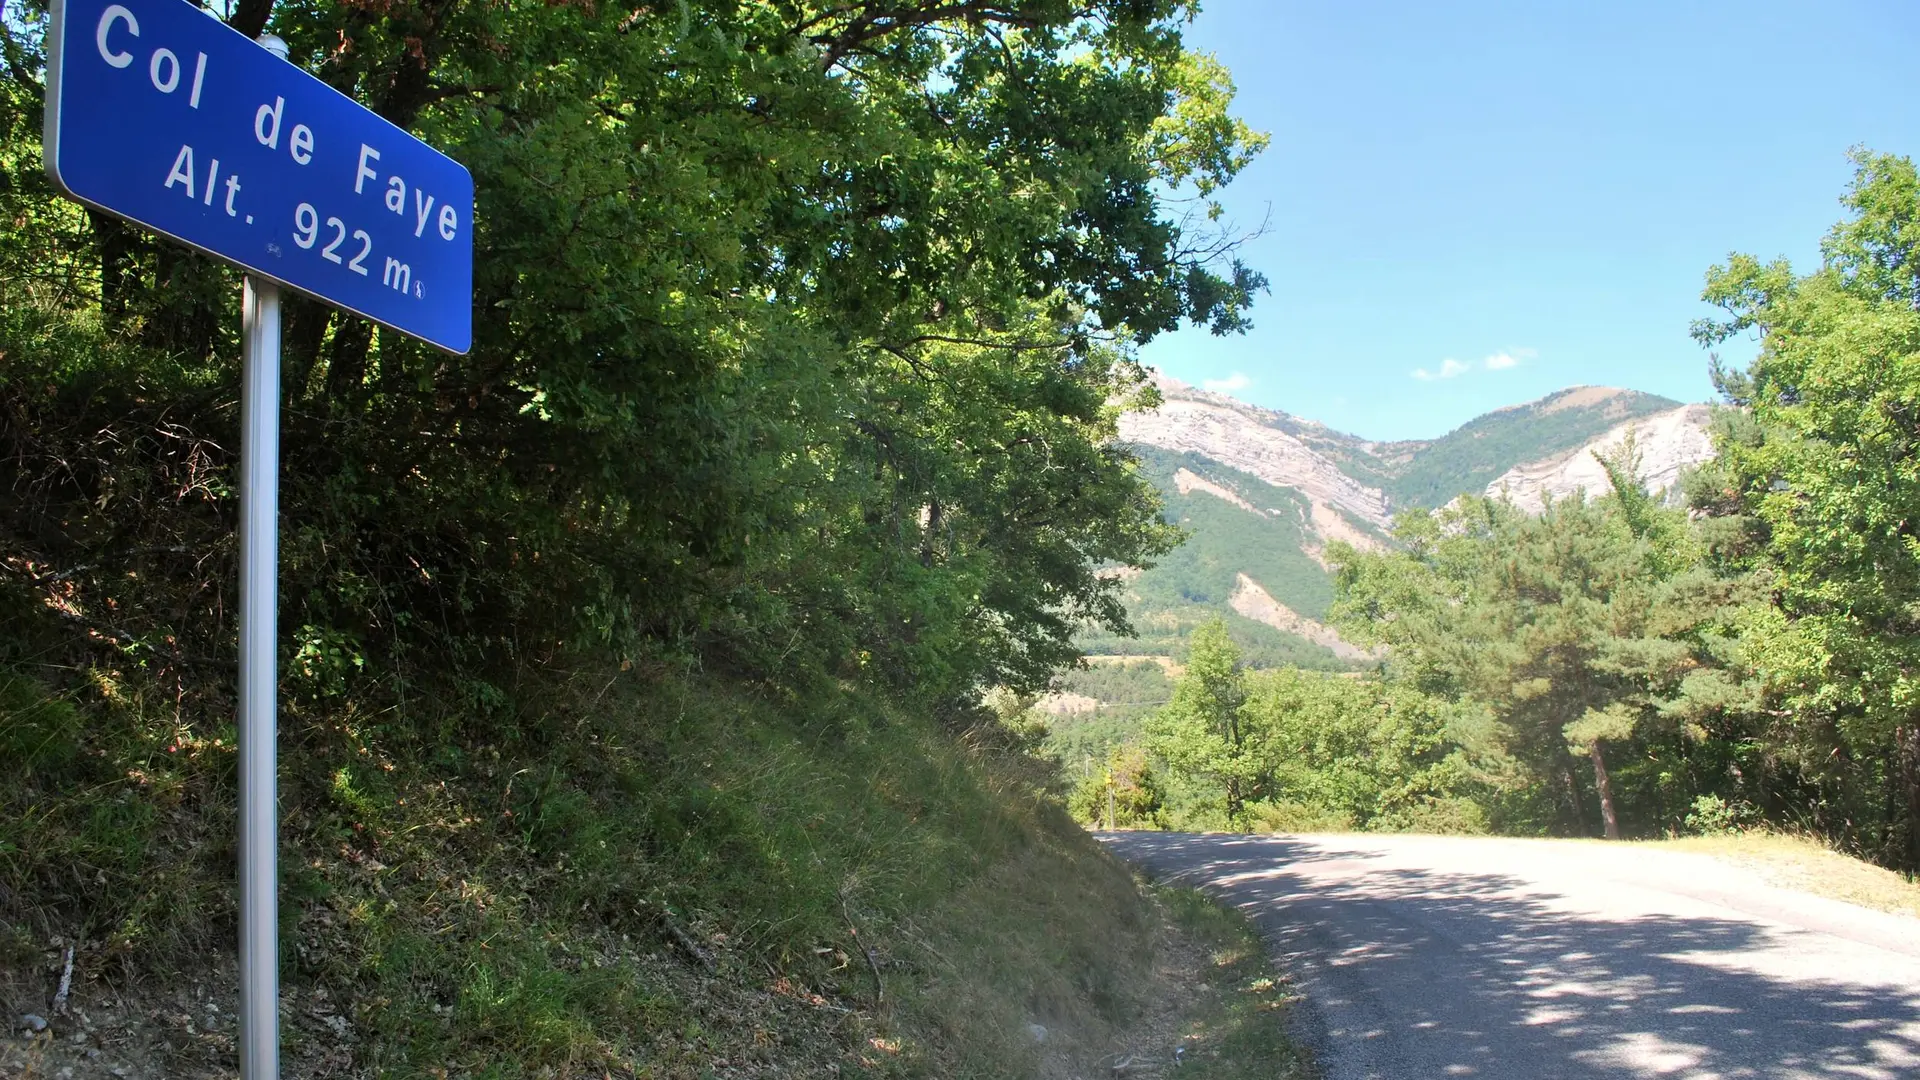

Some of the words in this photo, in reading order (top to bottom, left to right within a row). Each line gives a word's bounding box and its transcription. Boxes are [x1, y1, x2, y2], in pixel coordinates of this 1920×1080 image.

[96, 4, 208, 109] Col
[254, 96, 315, 165] de
[355, 143, 458, 241] Faye
[164, 145, 254, 225] Alt.
[292, 203, 372, 276] 922
[384, 255, 411, 295] m
